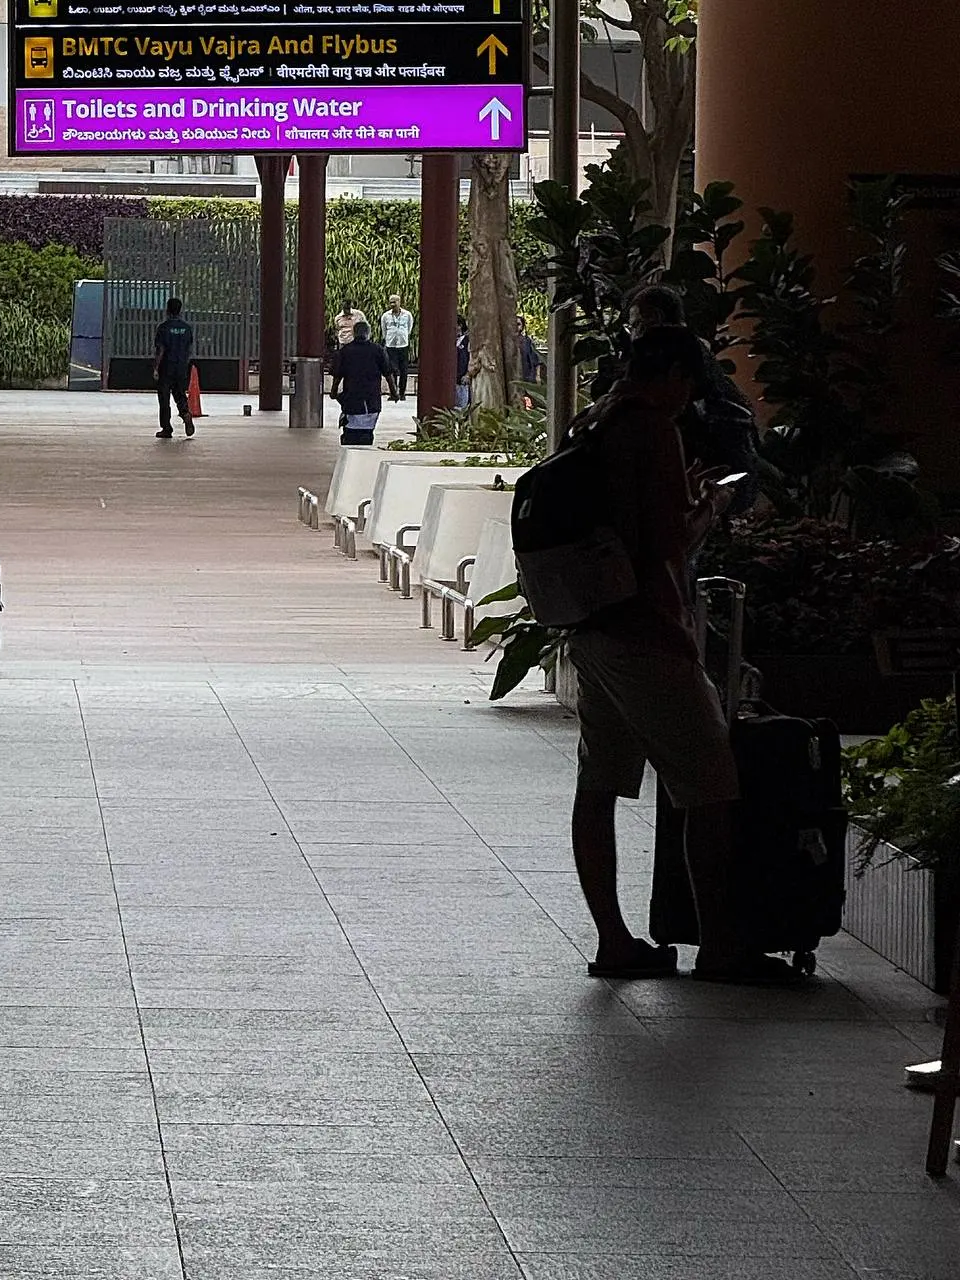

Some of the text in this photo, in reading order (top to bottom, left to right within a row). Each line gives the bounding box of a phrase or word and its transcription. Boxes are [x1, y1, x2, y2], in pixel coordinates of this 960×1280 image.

[62, 34, 398, 61] BMTC Vayu Vajra And Flybus
[185, 66, 216, 81] ಮತ್ತು
[332, 66, 352, 80] वायु
[375, 63, 396, 77] और
[62, 97, 363, 122] Toilets and Drinking Water
[149, 127, 180, 144] ಮತ್ತು
[285, 125, 421, 140] शौचालय और पीने का पानी
